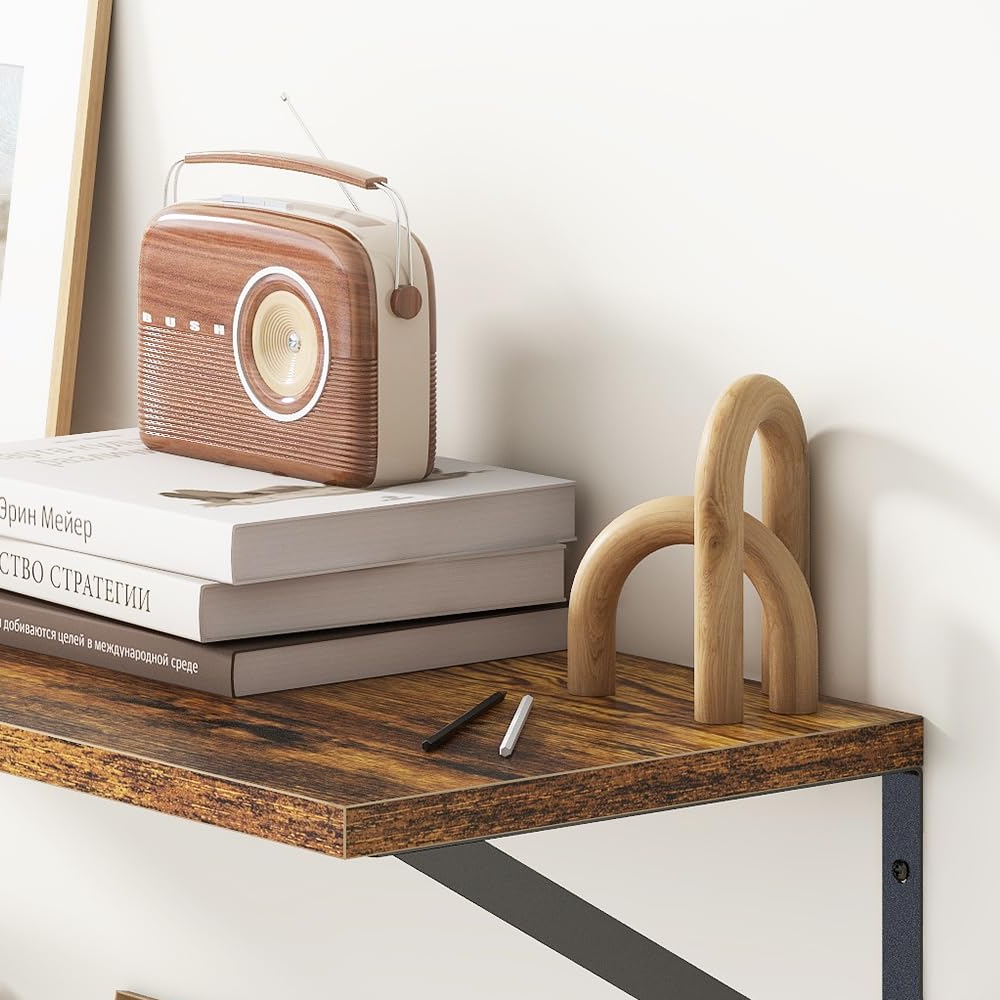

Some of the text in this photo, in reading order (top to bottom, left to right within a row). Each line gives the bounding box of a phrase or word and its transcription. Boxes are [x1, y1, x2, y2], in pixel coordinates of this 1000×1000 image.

[0, 496, 93, 543] Эрин Мейер
[50, 565, 151, 613] СТРАТЕГИИ
[3, 617, 57, 641] добиваются
[58, 629, 85, 648] целей
[87, 638, 93, 649] в
[94, 640, 170, 668] международной
[171, 656, 199, 674] среде
